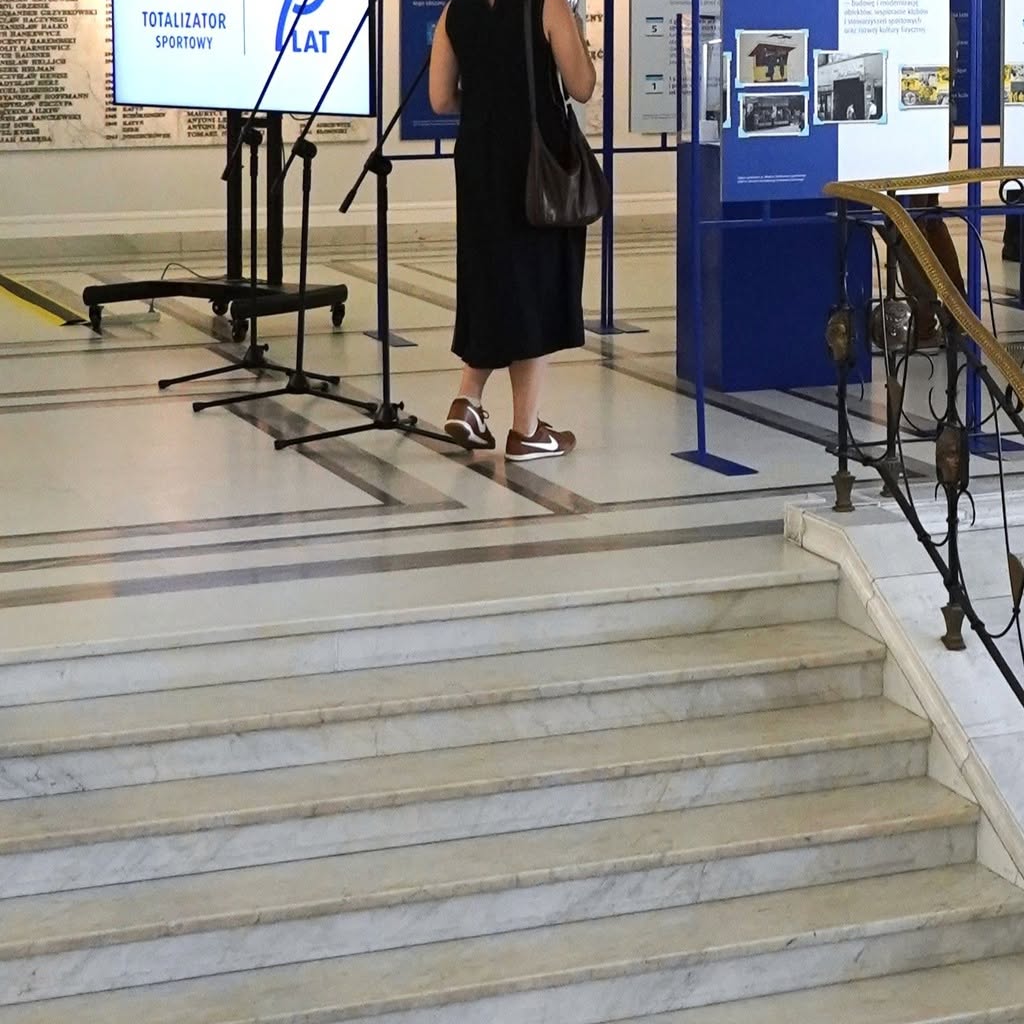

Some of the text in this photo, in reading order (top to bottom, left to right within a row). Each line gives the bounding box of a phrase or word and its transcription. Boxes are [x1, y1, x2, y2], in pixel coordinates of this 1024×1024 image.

[142, 11, 227, 29] TOTALIZATOR
[652, 25, 658, 33] 5
[155, 35, 214, 50] SPORTOWY
[292, 30, 330, 53] LAT
